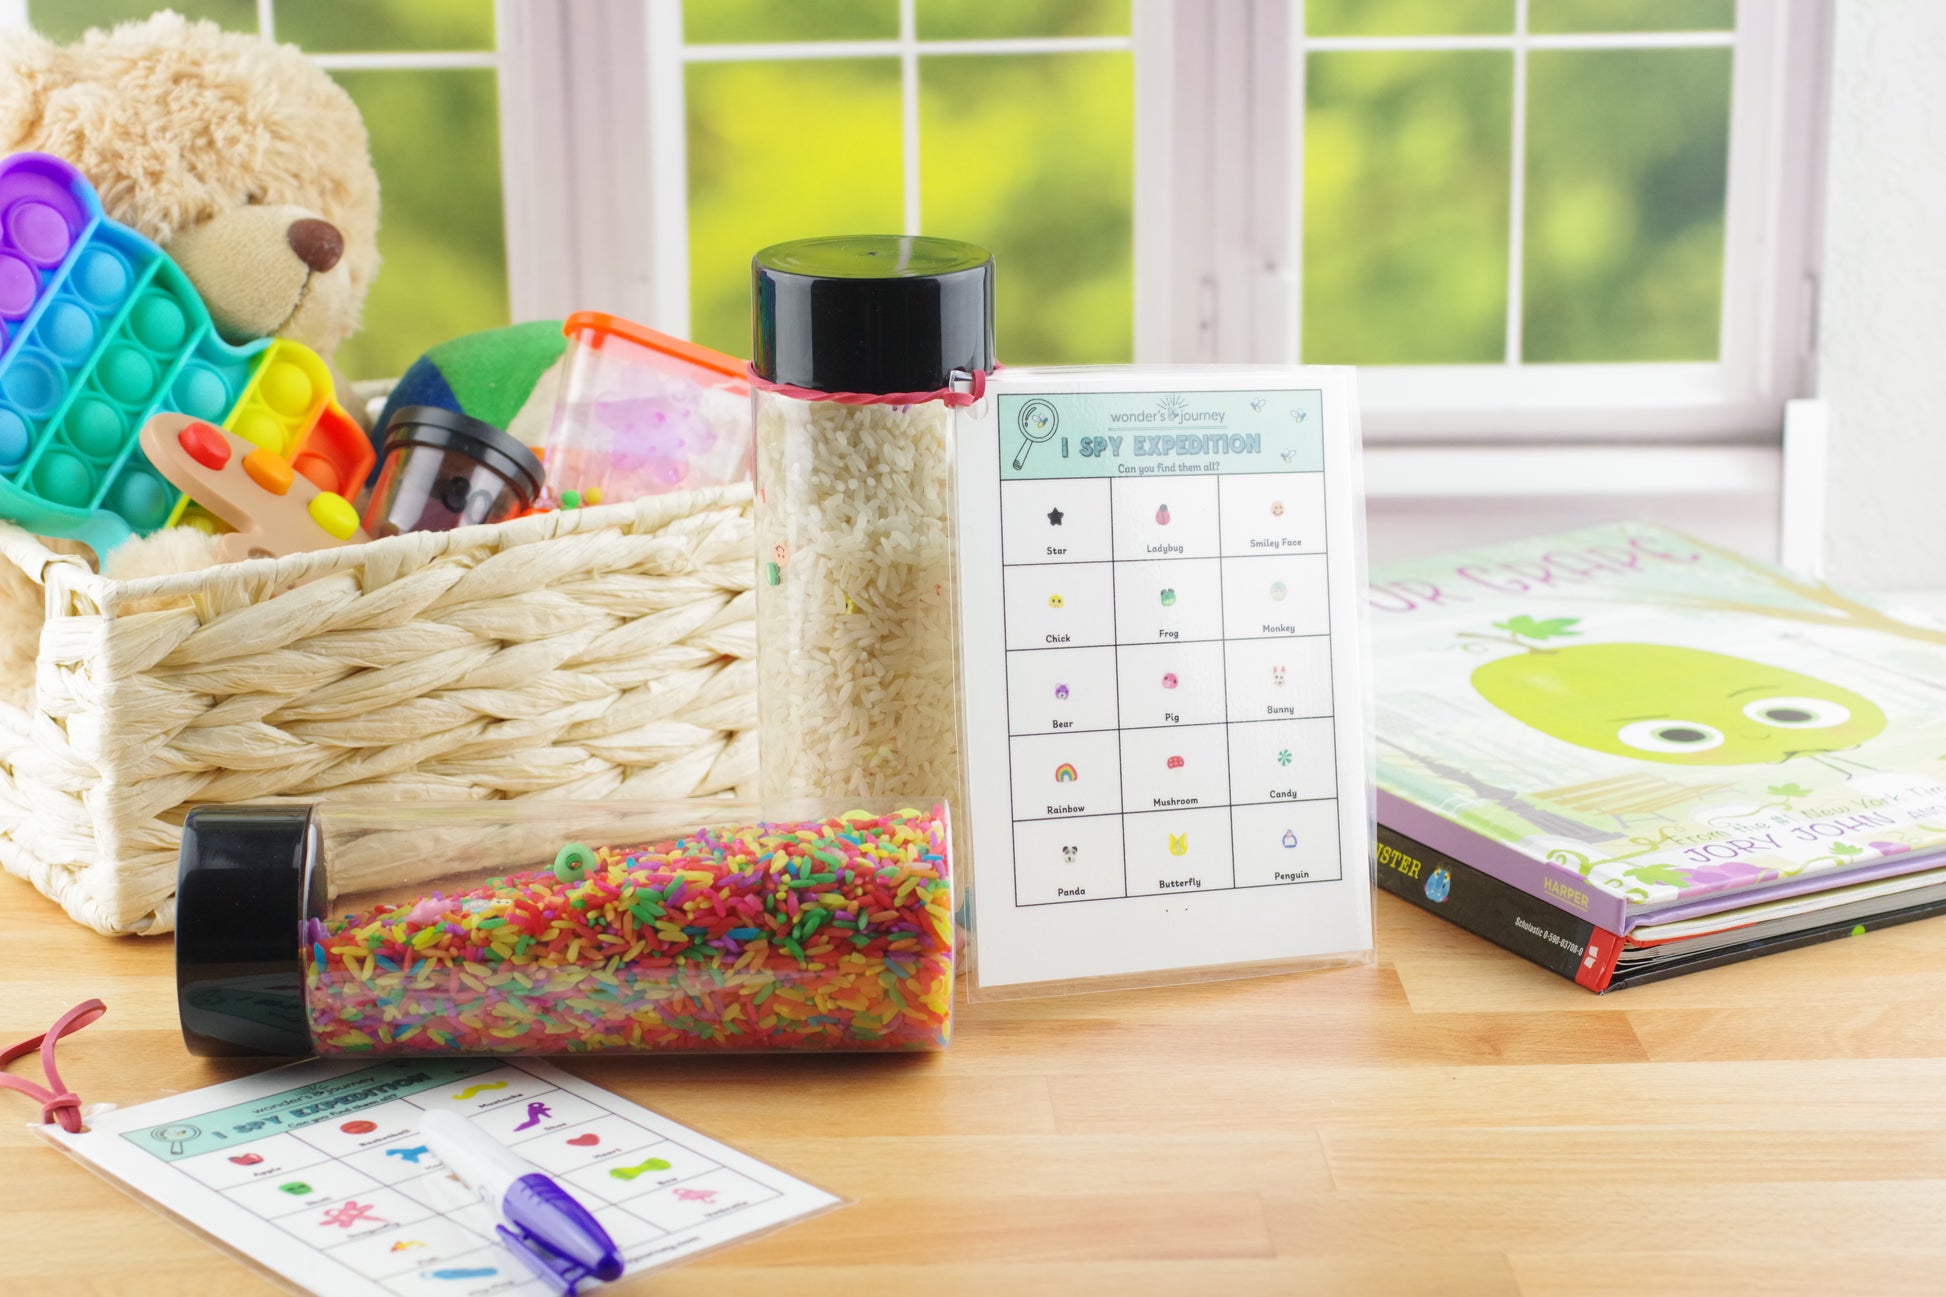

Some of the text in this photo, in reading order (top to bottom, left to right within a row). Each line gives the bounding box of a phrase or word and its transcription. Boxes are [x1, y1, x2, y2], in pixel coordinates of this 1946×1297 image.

[1111, 409, 1225, 426] wonder's journey
[1061, 433, 1261, 458] I SPY EXPEDITION
[1118, 462, 1220, 476] Can you find them all?
[1147, 543, 1184, 554] Ladybug
[1250, 538, 1302, 549] Smiley Face
[1046, 546, 1067, 555] Star
[1159, 629, 1179, 639] Frog
[1262, 623, 1295, 634] Monkey
[1045, 634, 1070, 643] Chick
[1267, 705, 1294, 715] Bunny
[1052, 719, 1073, 728] Bear
[1165, 713, 1179, 723] Pig
[1270, 789, 1297, 799] Candy
[1153, 796, 1198, 807] Mushroom
[1047, 804, 1085, 814] Rainbow
[1684, 833, 1783, 863] JORY
[1791, 811, 1897, 842] JOHN
[1275, 870, 1309, 881] Penguin
[1159, 877, 1201, 889] Butterfly
[1058, 887, 1086, 897] Panda
[1544, 877, 1589, 907] HARPER
[1514, 916, 1543, 937] Scholastic
[289, 1072, 433, 1118] EXPEDITION
